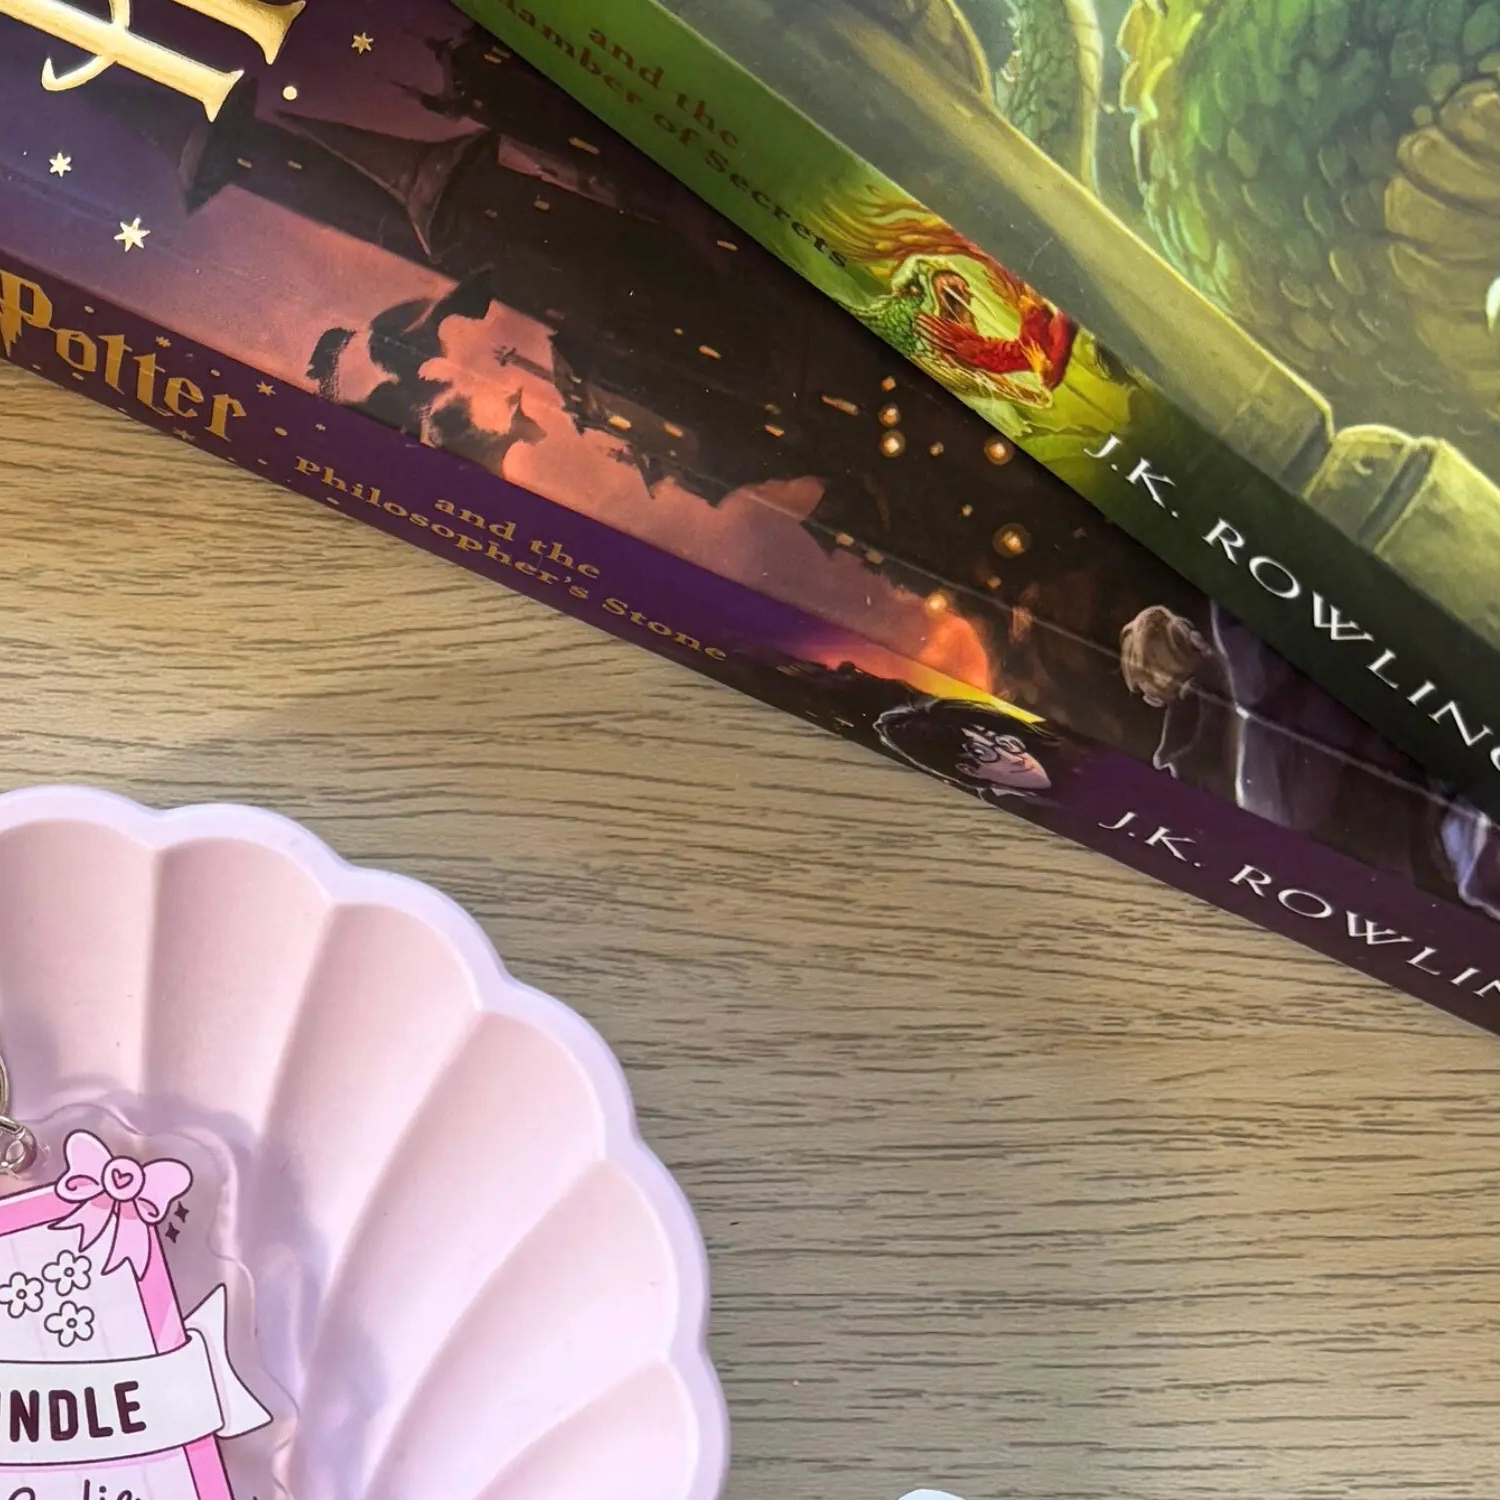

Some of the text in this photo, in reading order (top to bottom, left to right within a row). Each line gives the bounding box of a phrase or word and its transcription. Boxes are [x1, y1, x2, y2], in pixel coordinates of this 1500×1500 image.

[588, 27, 740, 150] and the
[653, 111, 701, 147] of
[704, 148, 848, 269] Secrets
[1083, 433, 1181, 519] J.K.
[294, 455, 728, 662] Philosopher's Stone
[433, 498, 601, 580] and the
[1099, 810, 1206, 869] J.K.
